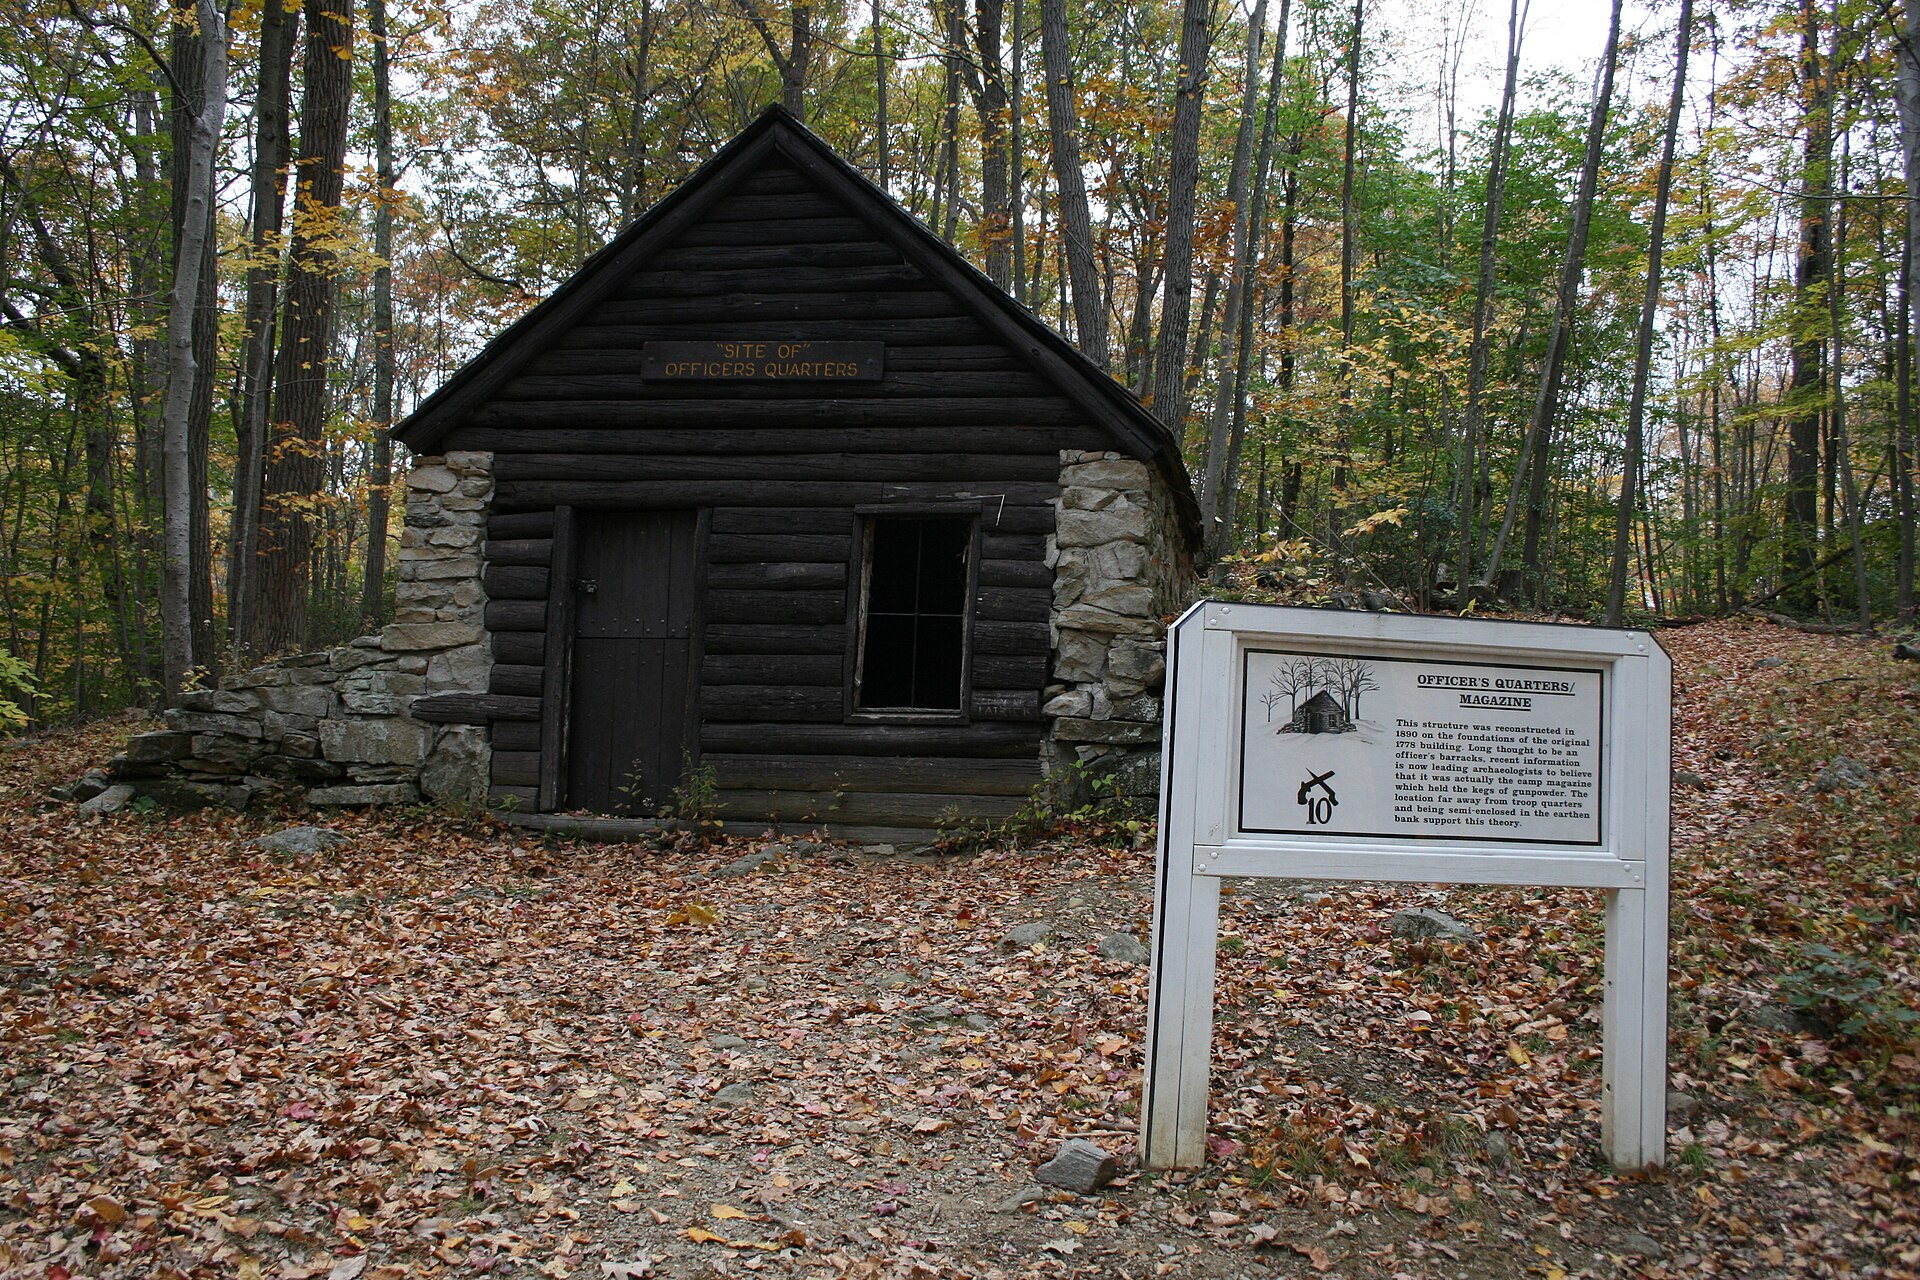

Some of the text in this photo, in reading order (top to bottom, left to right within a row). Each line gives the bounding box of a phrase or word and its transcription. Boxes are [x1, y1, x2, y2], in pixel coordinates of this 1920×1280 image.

[665, 363, 858, 378] OFFICERS QUARTERS
[1417, 675, 1575, 691] OFFICER'S QUARTERS/
[1459, 694, 1531, 707] MAGAZINE
[1396, 719, 1418, 728] This
[1422, 720, 1469, 730] structure
[1495, 723, 1561, 734] reconstructed
[1565, 726, 1574, 734] in
[1396, 730, 1418, 739] 1890
[1438, 732, 1453, 740] the
[1457, 733, 1515, 743] foundations
[1519, 735, 1529, 744] of
[1532, 736, 1548, 744] the
[1551, 737, 1590, 748] original
[1396, 741, 1416, 749] 1778
[1420, 742, 1464, 753] building.
[1468, 744, 1492, 754] Long
[1496, 745, 1534, 756] thought
[1538, 747, 1548, 755] to
[1552, 747, 1562, 756] be
[1395, 751, 1580, 766] officer's barracks, recent information
[1395, 762, 1404, 770] is
[1432, 763, 1468, 774] leading
[1473, 765, 1542, 777] archaeologists
[1546, 768, 1556, 776] to
[1560, 768, 1592, 777] believe
[1395, 772, 1416, 781] that
[1420, 773, 1428, 781] it
[1454, 774, 1494, 786] actually
[1498, 776, 1513, 784] the
[1517, 778, 1542, 787] camp
[1546, 778, 1592, 789] magazine
[1395, 783, 1588, 798] which held the kegs of gunpowder. The
[1395, 794, 1582, 810] location far away from troop quarters
[1306, 797, 1332, 825] 10
[1394, 804, 1590, 818] and being semi-enclosed in the earthen
[1395, 815, 1522, 829] bank support this theory.
